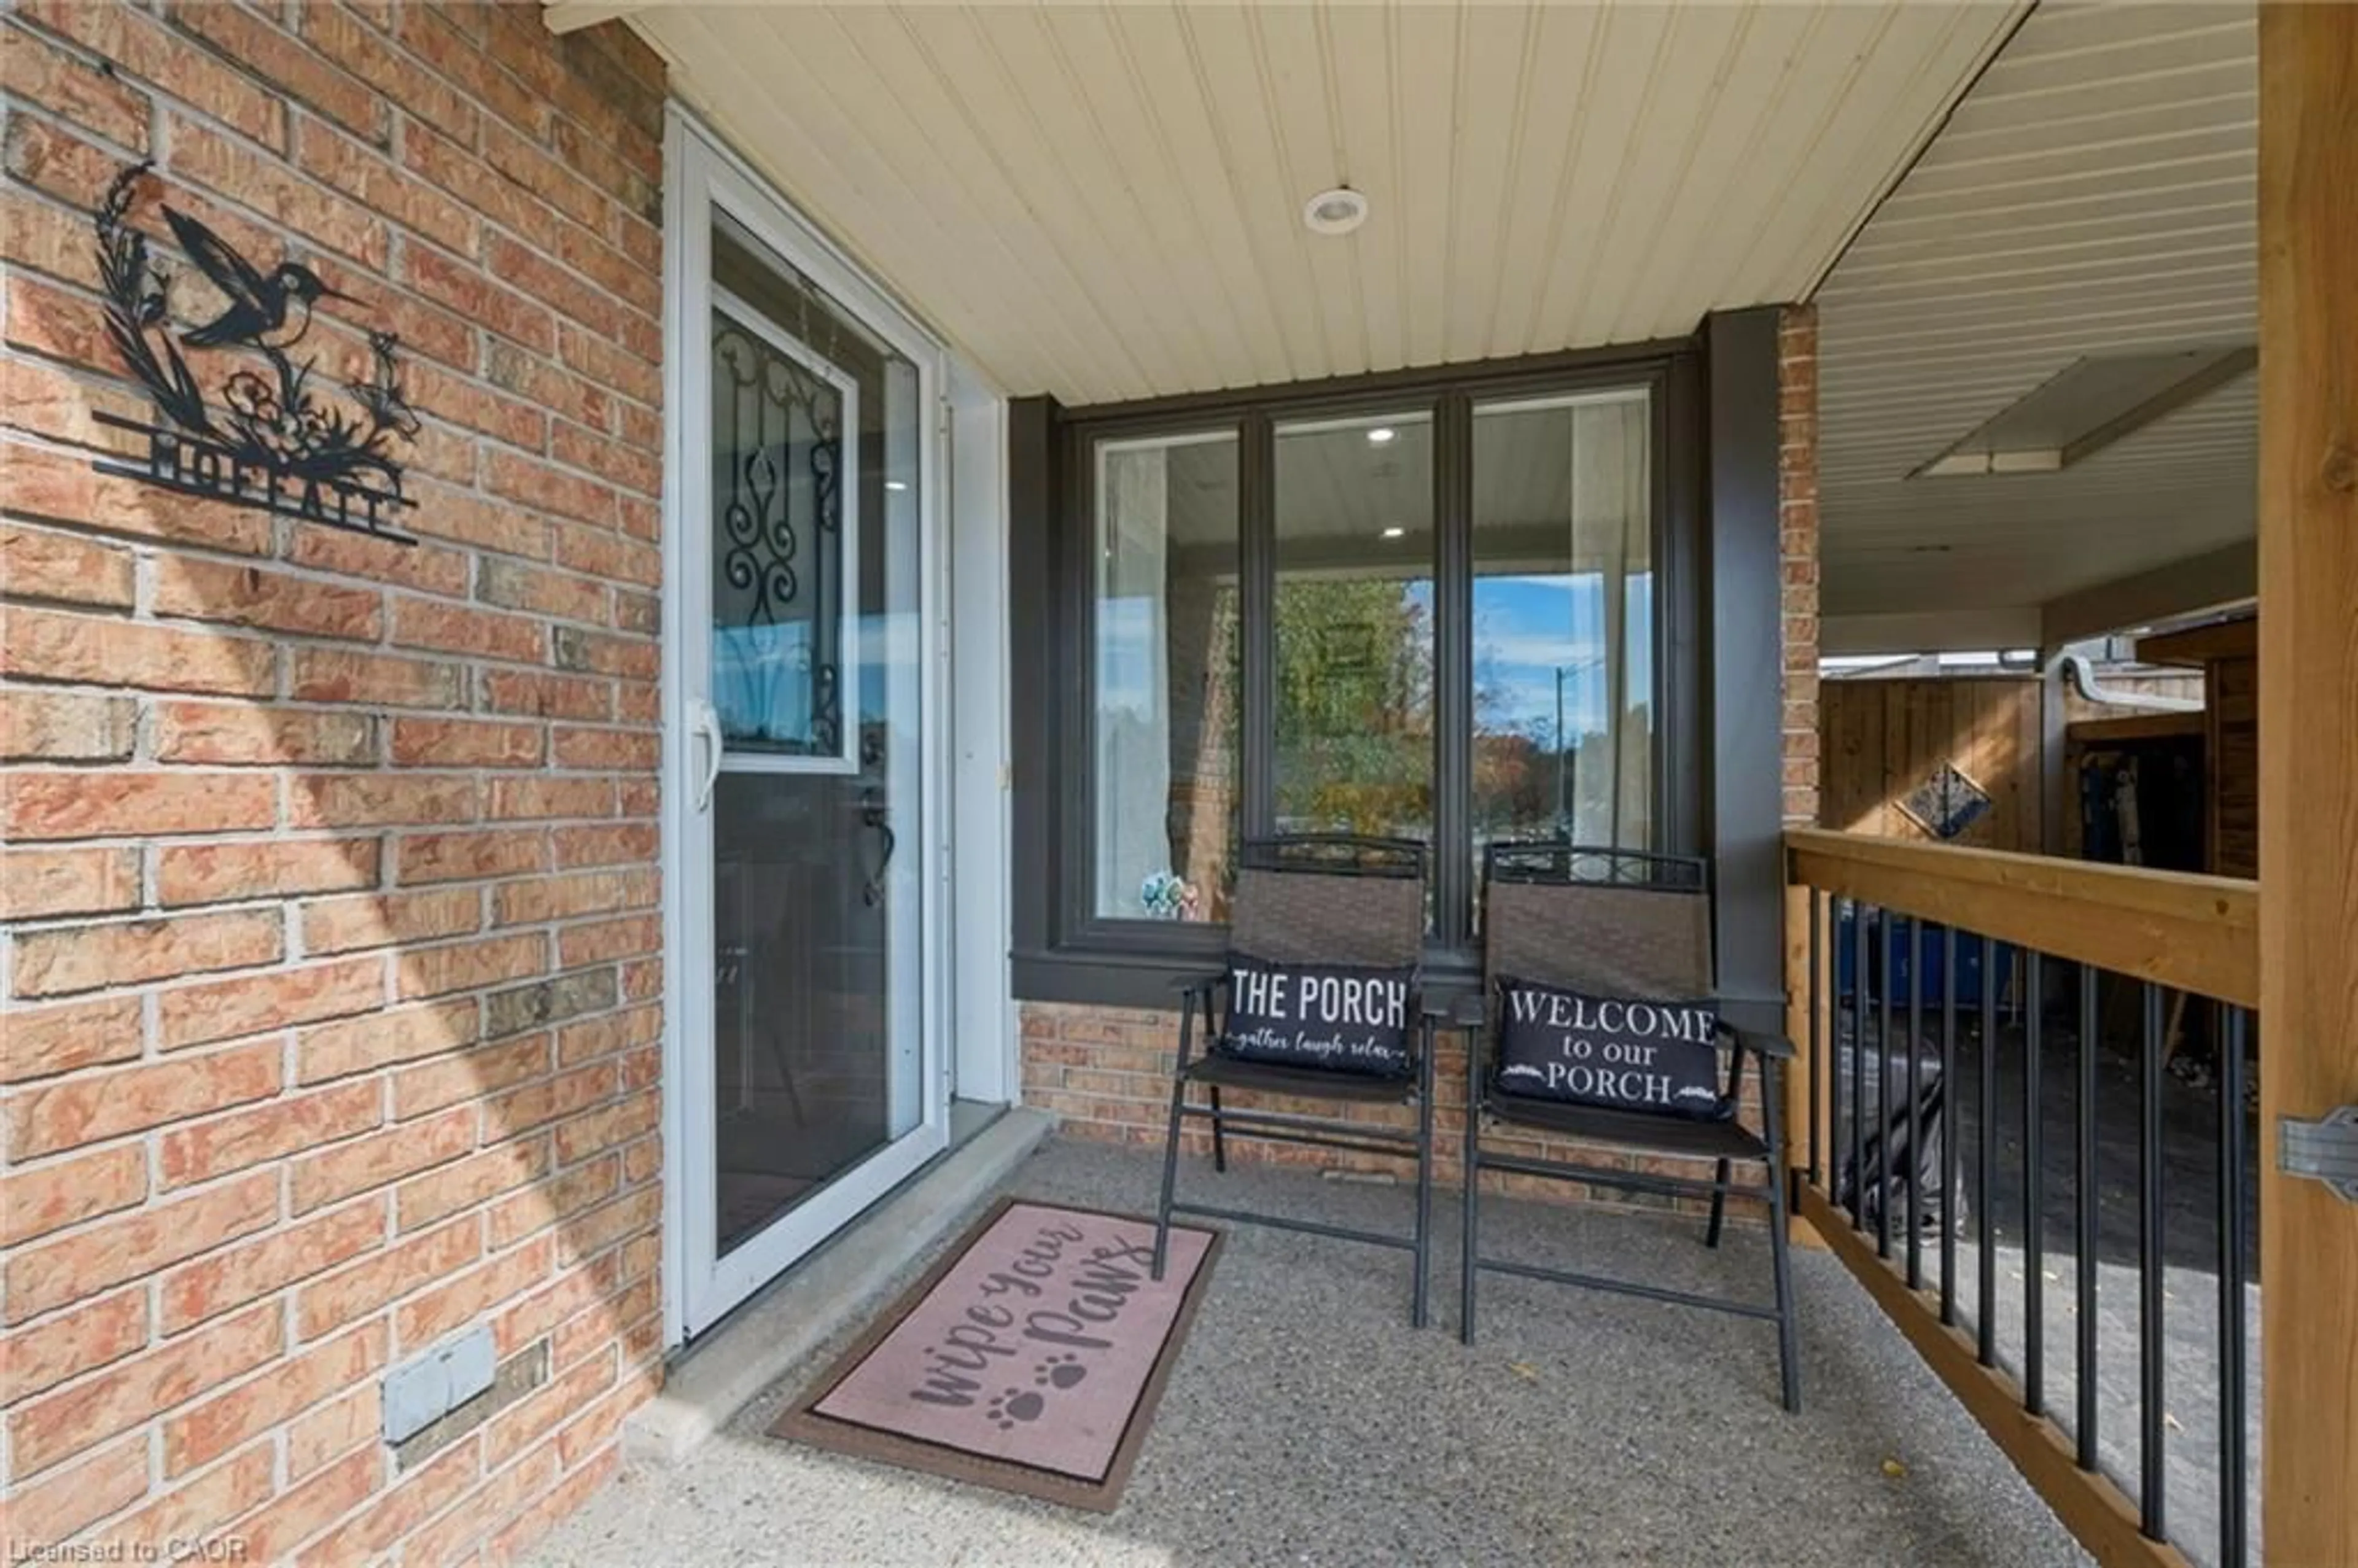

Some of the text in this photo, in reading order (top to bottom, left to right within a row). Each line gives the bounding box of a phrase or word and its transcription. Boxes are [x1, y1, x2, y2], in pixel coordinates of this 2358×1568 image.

[1233, 969, 1406, 1030] THE PORCH
[1510, 990, 1715, 1046] WELCOME
[1295, 1031, 1344, 1059] laugh
[1563, 1035, 1657, 1066] to our
[1547, 1062, 1672, 1104] PORCH
